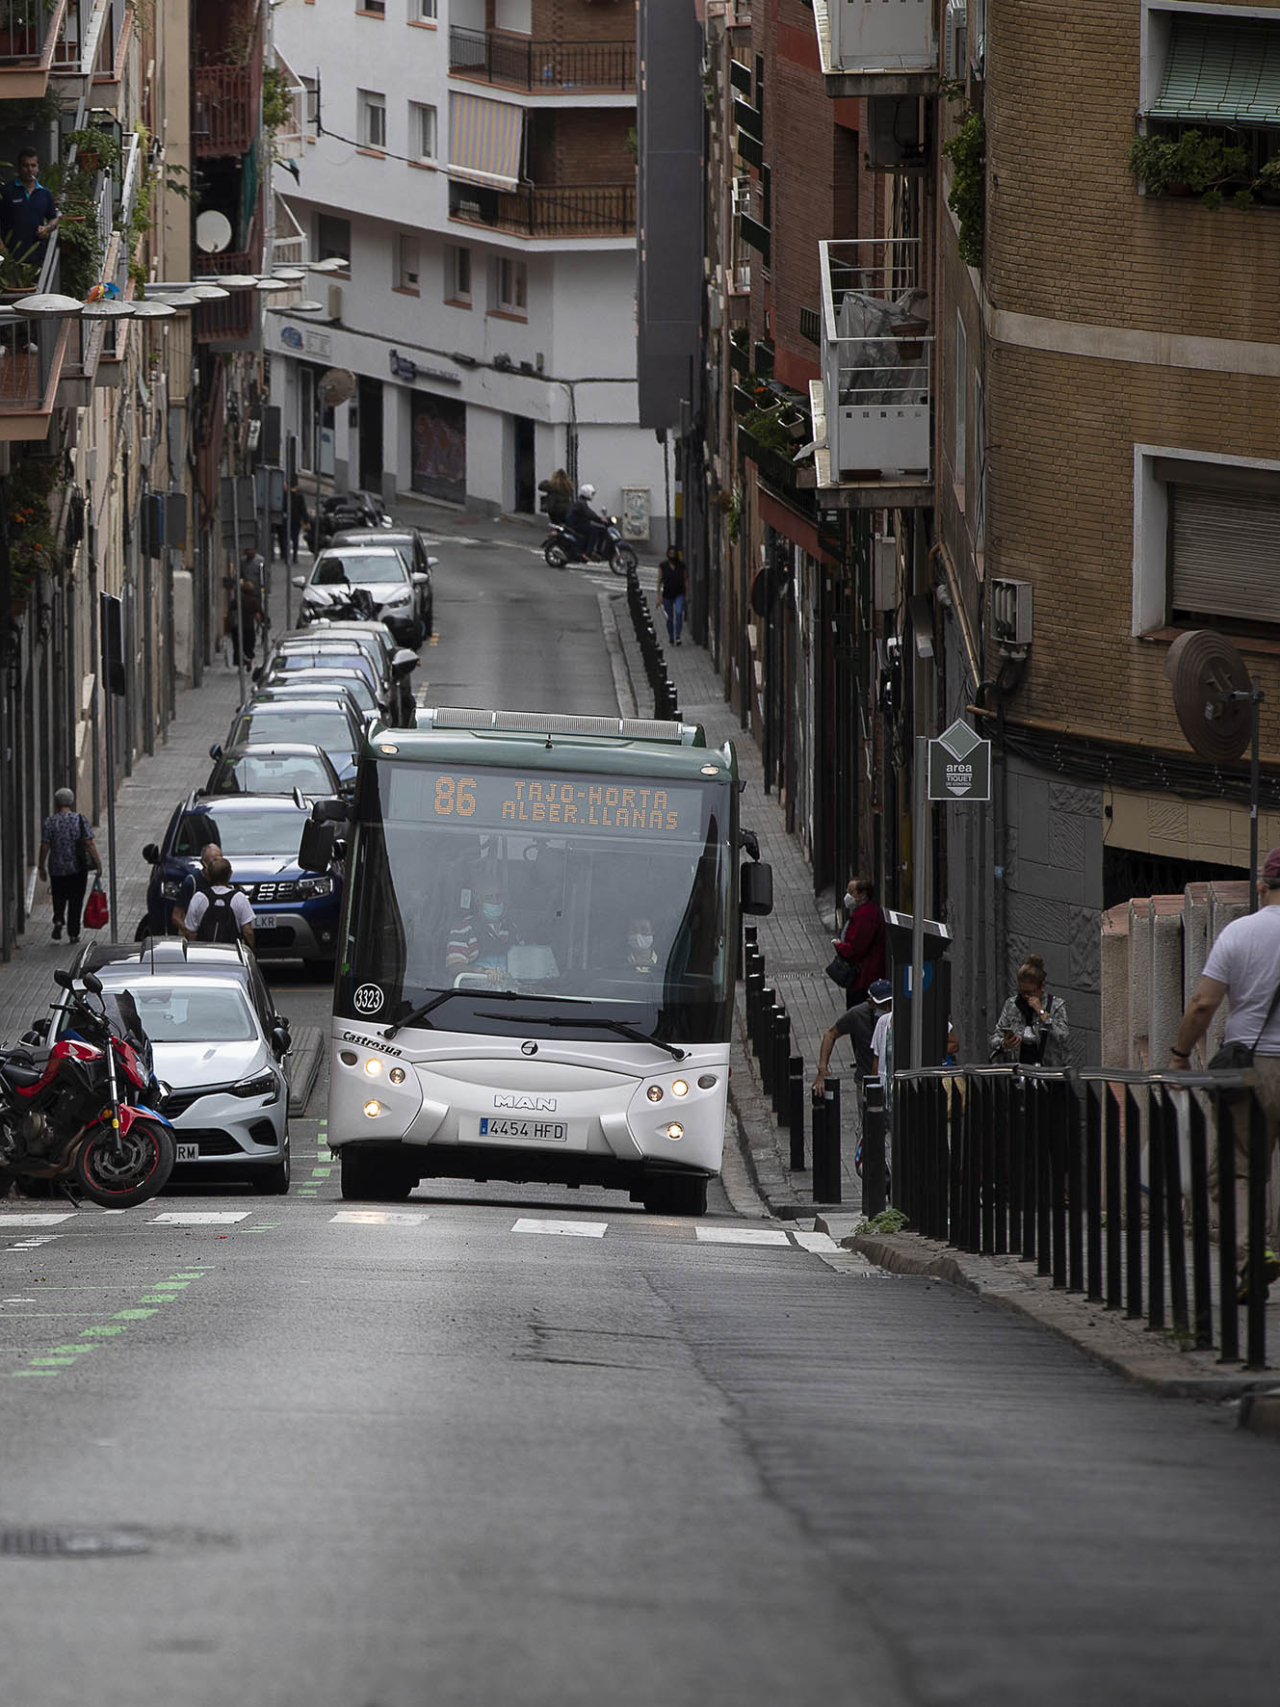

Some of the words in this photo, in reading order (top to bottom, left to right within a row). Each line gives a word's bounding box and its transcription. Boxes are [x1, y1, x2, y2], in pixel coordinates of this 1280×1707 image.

[946, 764, 973, 773] area
[433, 775, 478, 817] 86
[514, 781, 669, 810] TAJO-HORTA
[501, 800, 678, 830] ALBER.LLANAS
[356, 989, 381, 1009] 3323
[342, 1031, 403, 1057] Castrosua
[494, 1094, 557, 1113] MAN
[490, 1120, 529, 1136] 4454
[533, 1123, 564, 1140] HFD
